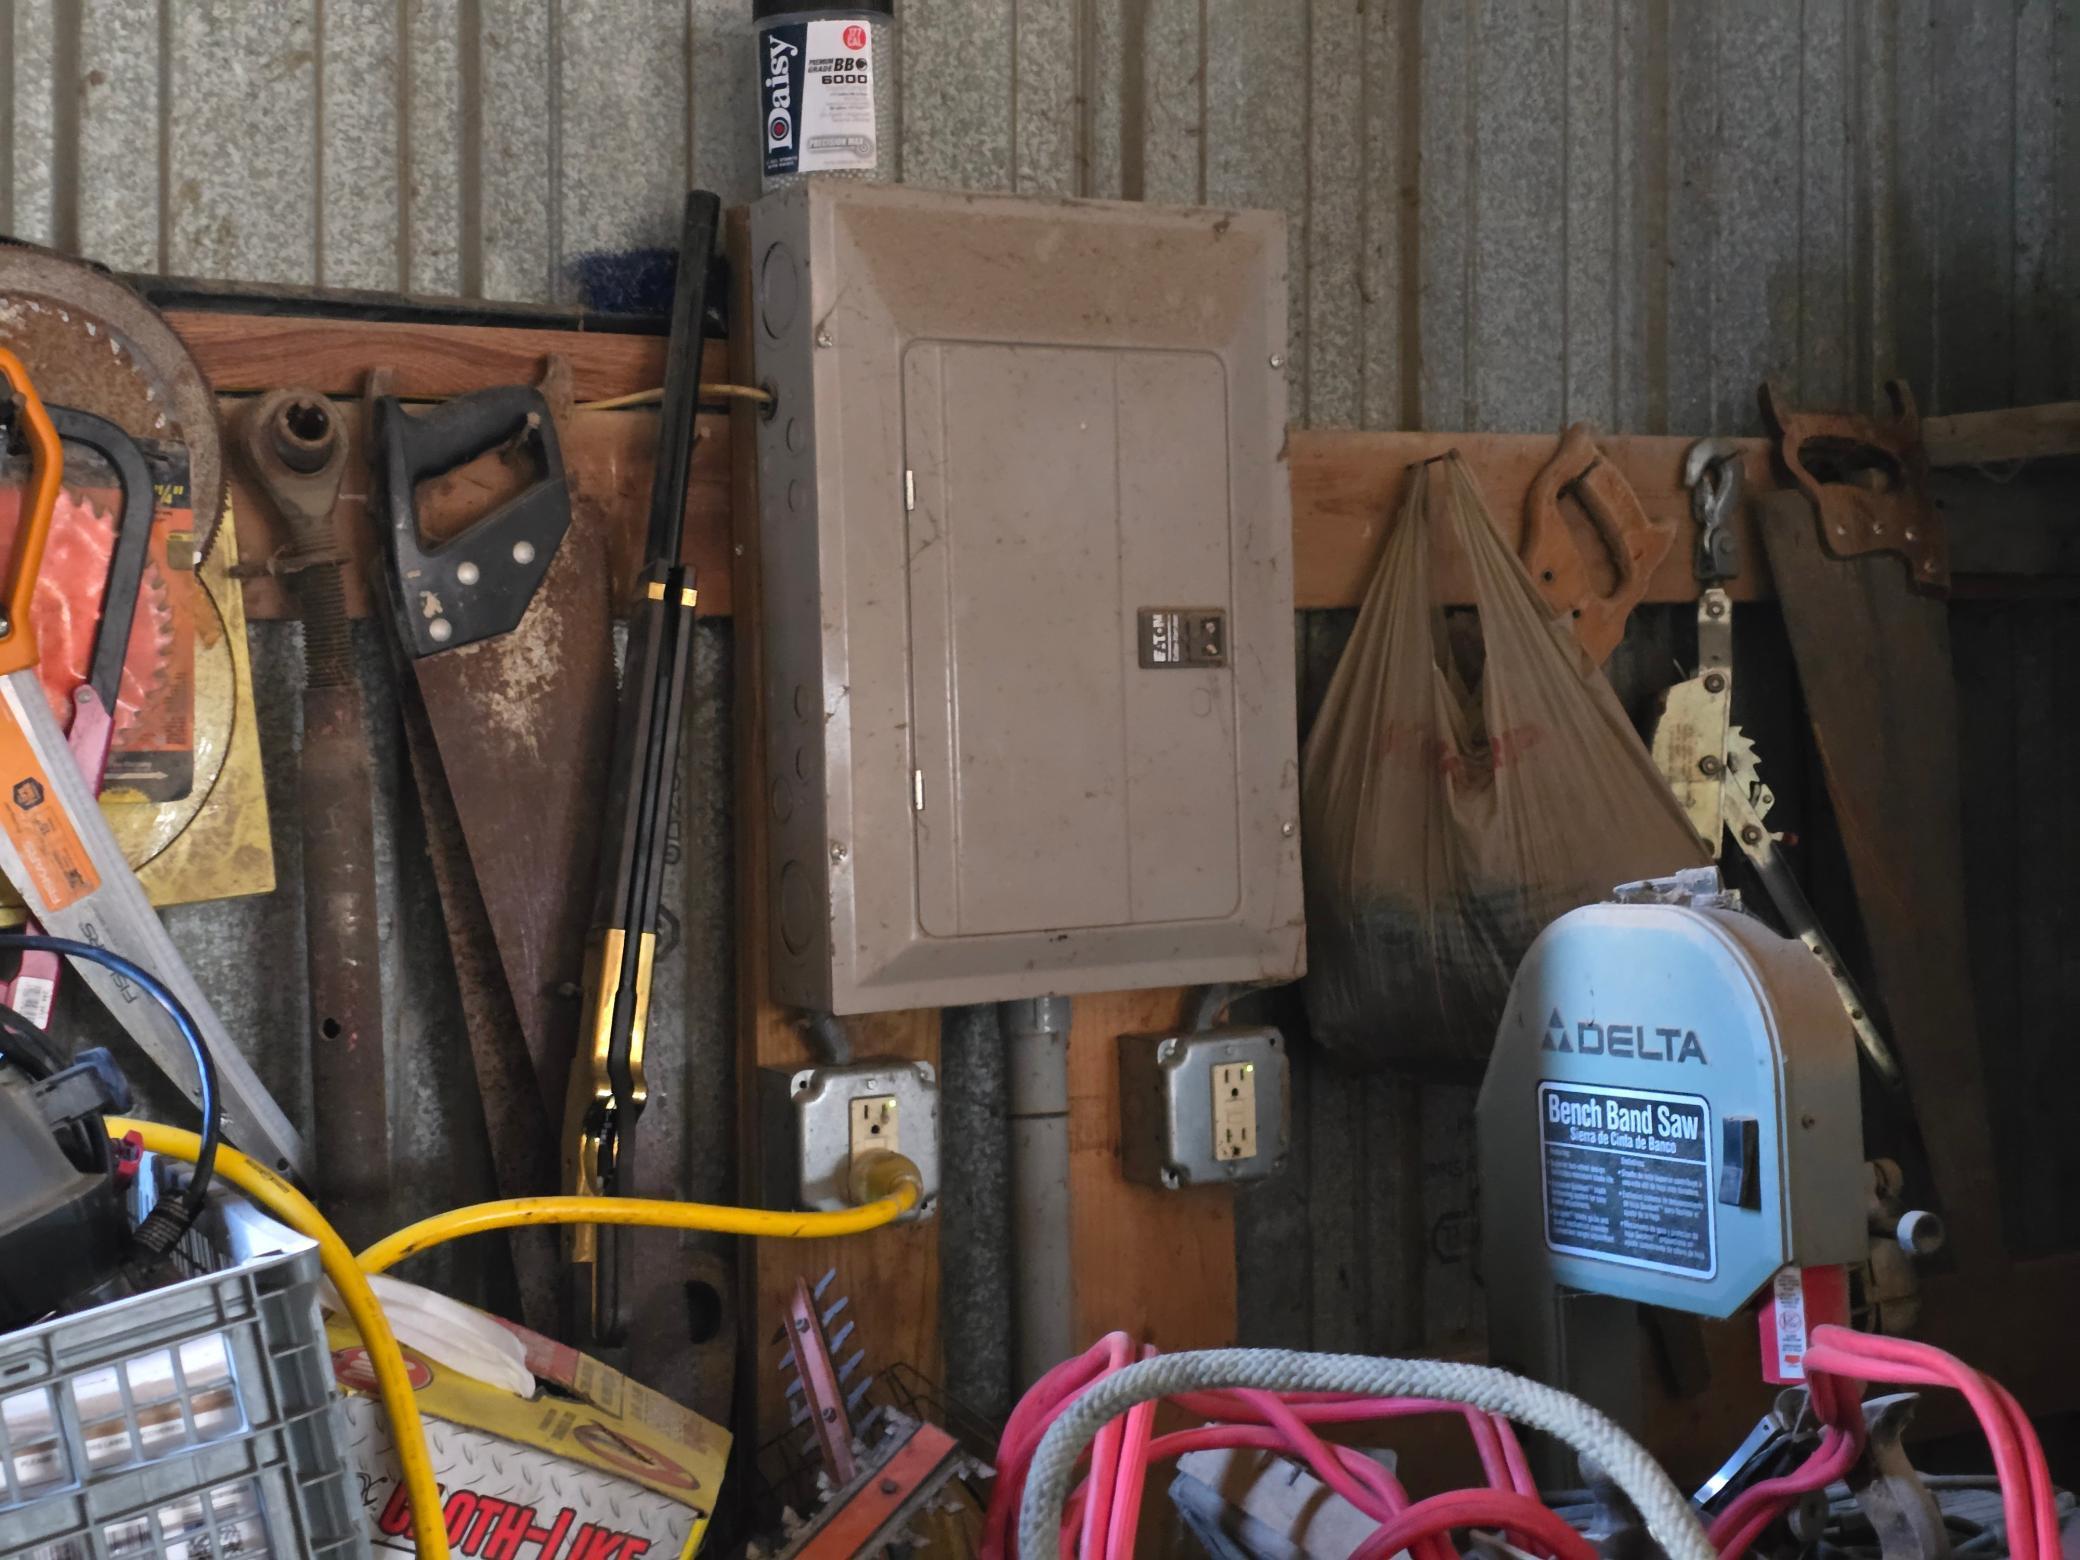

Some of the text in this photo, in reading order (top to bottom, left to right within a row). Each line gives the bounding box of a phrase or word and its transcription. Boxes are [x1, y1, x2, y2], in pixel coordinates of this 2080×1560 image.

[807, 65, 833, 73] GRADE
[821, 74, 868, 85] 6000
[833, 57, 855, 72] BB
[766, 36, 798, 154] Daisy
[1152, 613, 1167, 662] EATON
[80, 922, 139, 1004] FISRS
[1577, 1022, 1708, 1066] DELTA
[1548, 1093, 1699, 1140] Bench Band Saw
[1597, 1130, 1609, 1145] de
[1635, 1135, 1647, 1150] de
[1648, 1135, 1677, 1154] Banco
[379, 1479, 652, 1560] COTH-LIK
